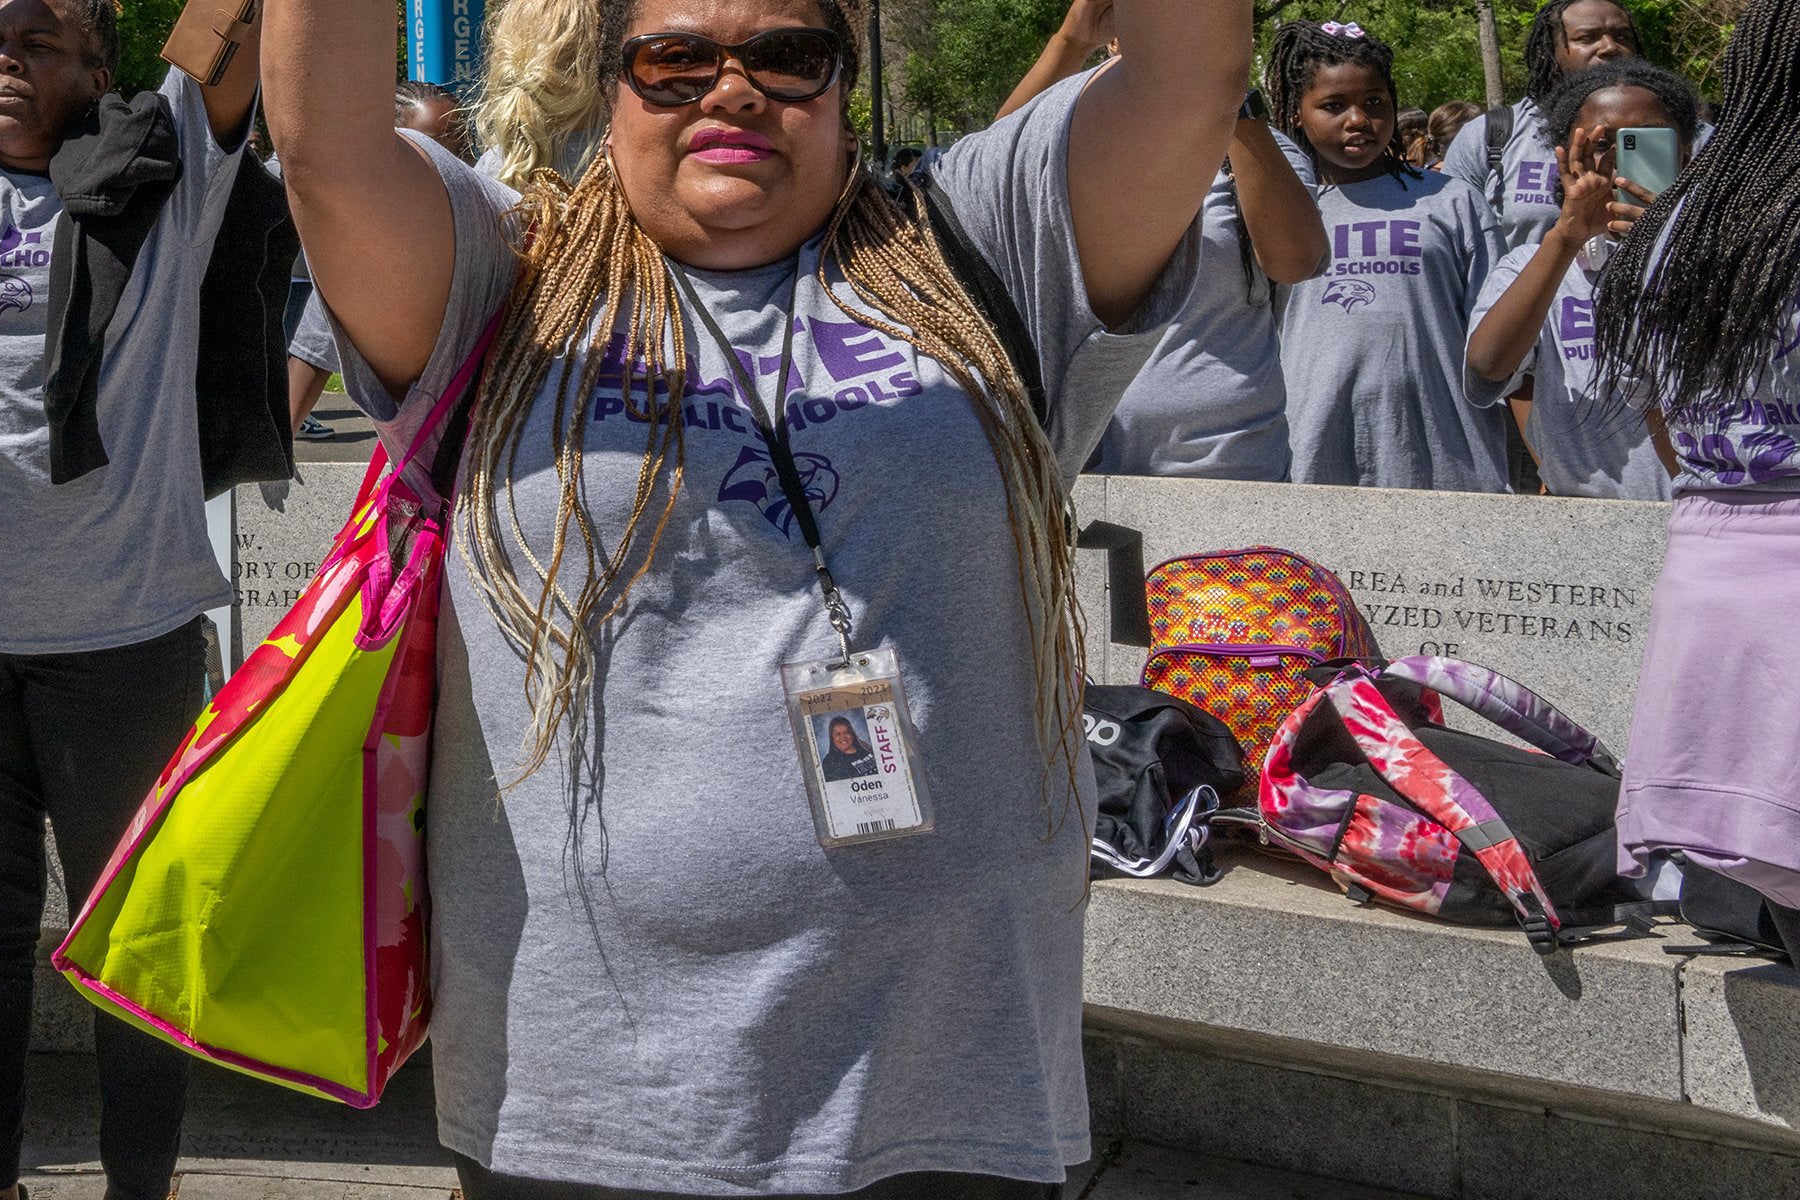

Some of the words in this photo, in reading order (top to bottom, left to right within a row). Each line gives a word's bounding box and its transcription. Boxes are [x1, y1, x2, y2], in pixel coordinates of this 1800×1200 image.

[1514, 193, 1556, 205] PUBL
[1334, 220, 1422, 259] ITE
[1336, 261, 1421, 275] SCHOOLS
[231, 562, 277, 579] ORY
[285, 562, 316, 579] OF
[1332, 570, 1409, 593] REA
[1419, 577, 1464, 598] and
[1476, 578, 1636, 608] WESTERN
[1364, 604, 1442, 629] YZED
[1455, 610, 1633, 643] VETERANS
[860, 684, 886, 696] 2023
[874, 726, 897, 774] STAFF
[851, 780, 883, 792] Oden
